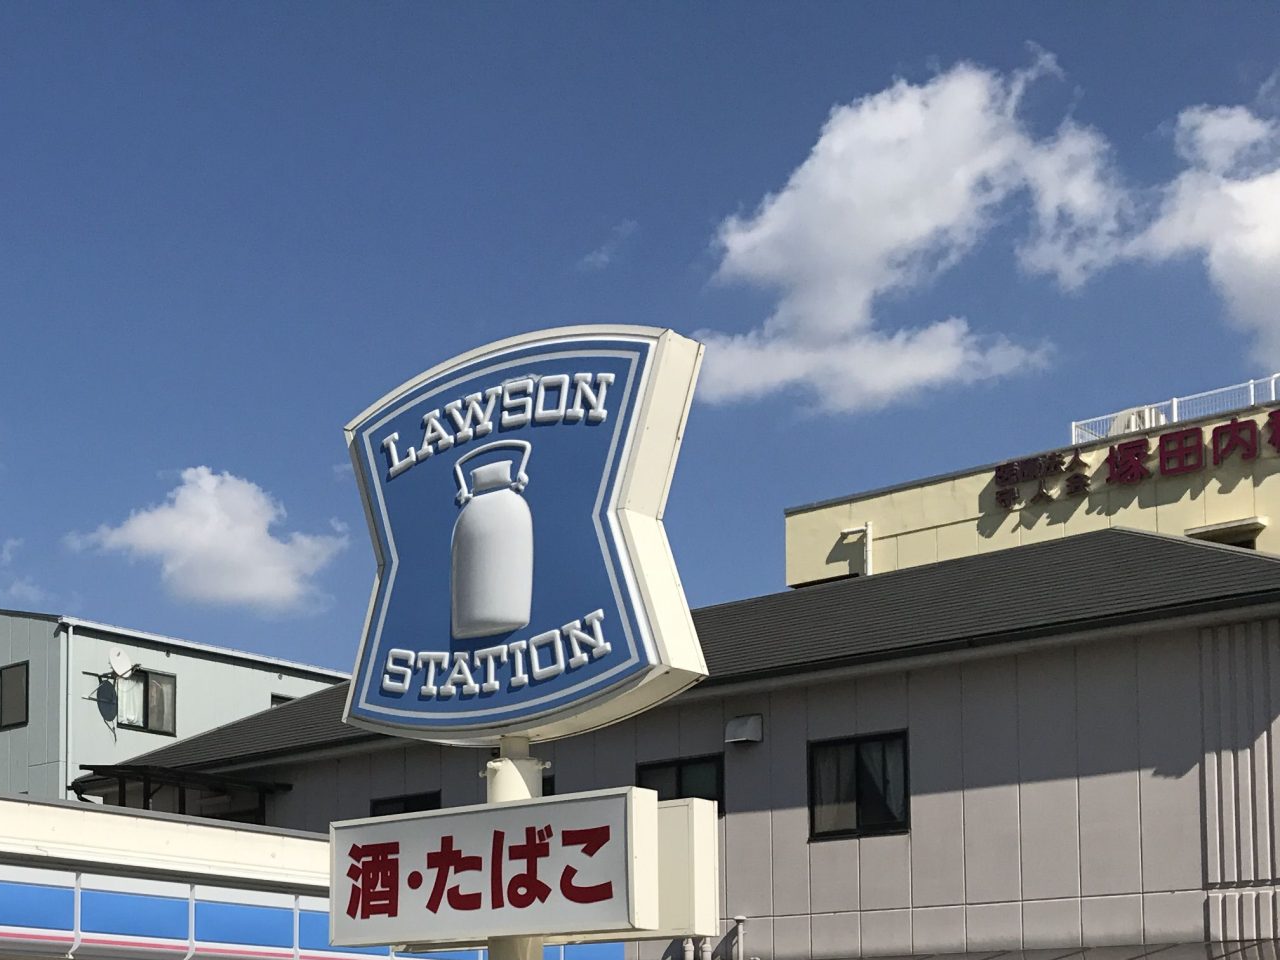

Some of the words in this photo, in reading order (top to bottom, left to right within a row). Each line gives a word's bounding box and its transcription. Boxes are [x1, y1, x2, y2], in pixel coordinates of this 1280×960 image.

[382, 373, 615, 478] LAWSON
[382, 609, 611, 696] STATION
[346, 824, 613, 920] 酒・たばこ
